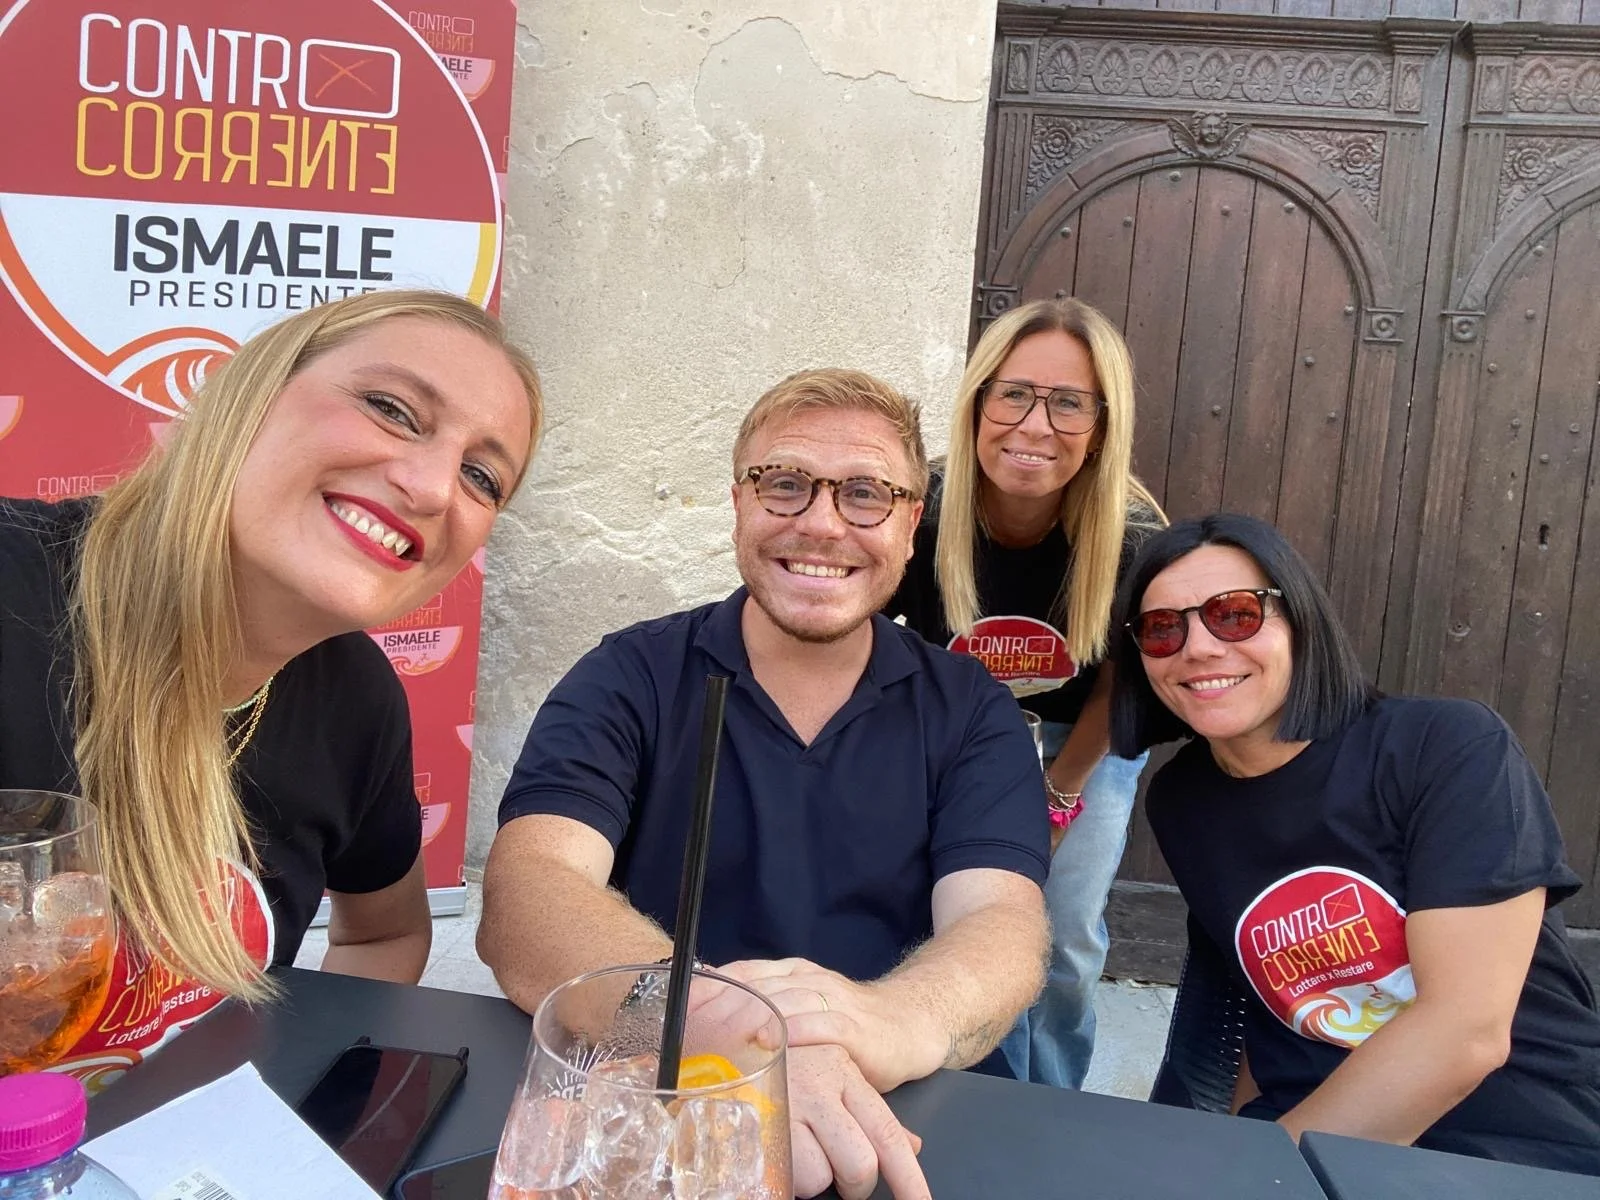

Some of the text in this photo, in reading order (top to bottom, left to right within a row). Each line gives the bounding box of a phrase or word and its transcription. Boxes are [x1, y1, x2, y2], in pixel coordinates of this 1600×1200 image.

[113, 214, 394, 282] ISMAELE
[129, 279, 378, 310] PRESIDENT
[383, 630, 441, 648] ISMAELE
[386, 643, 437, 654] PRESIDENTE
[1288, 972, 1328, 998] Lottare
[1333, 960, 1375, 979] Restare
[105, 1015, 160, 1047] Lottare
